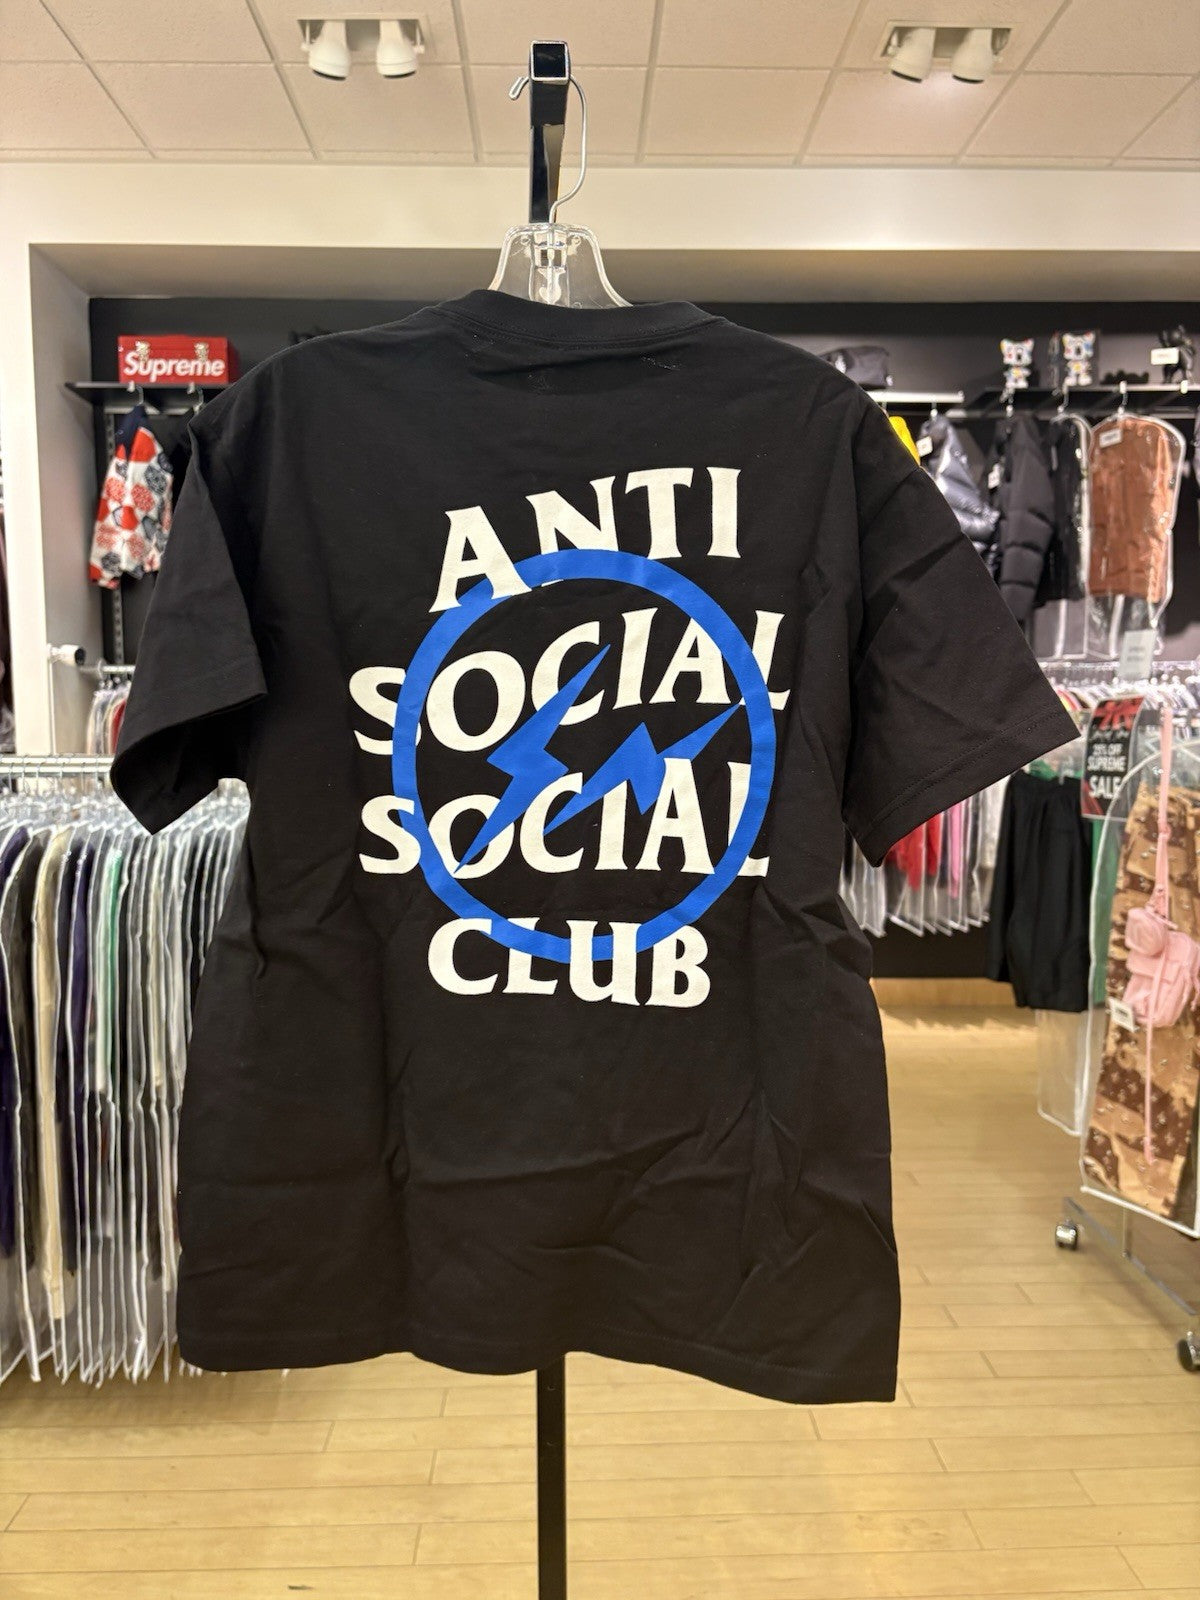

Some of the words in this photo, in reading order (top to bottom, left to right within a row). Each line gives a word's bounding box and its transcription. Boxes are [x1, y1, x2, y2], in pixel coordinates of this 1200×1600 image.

[123, 351, 225, 382] Supreme
[429, 467, 741, 612] ANTI
[349, 608, 791, 756] SOCIAL
[1087, 755, 1126, 772] SUPREME
[359, 757, 770, 880] SOCIAL
[427, 917, 711, 1008] CLUB
